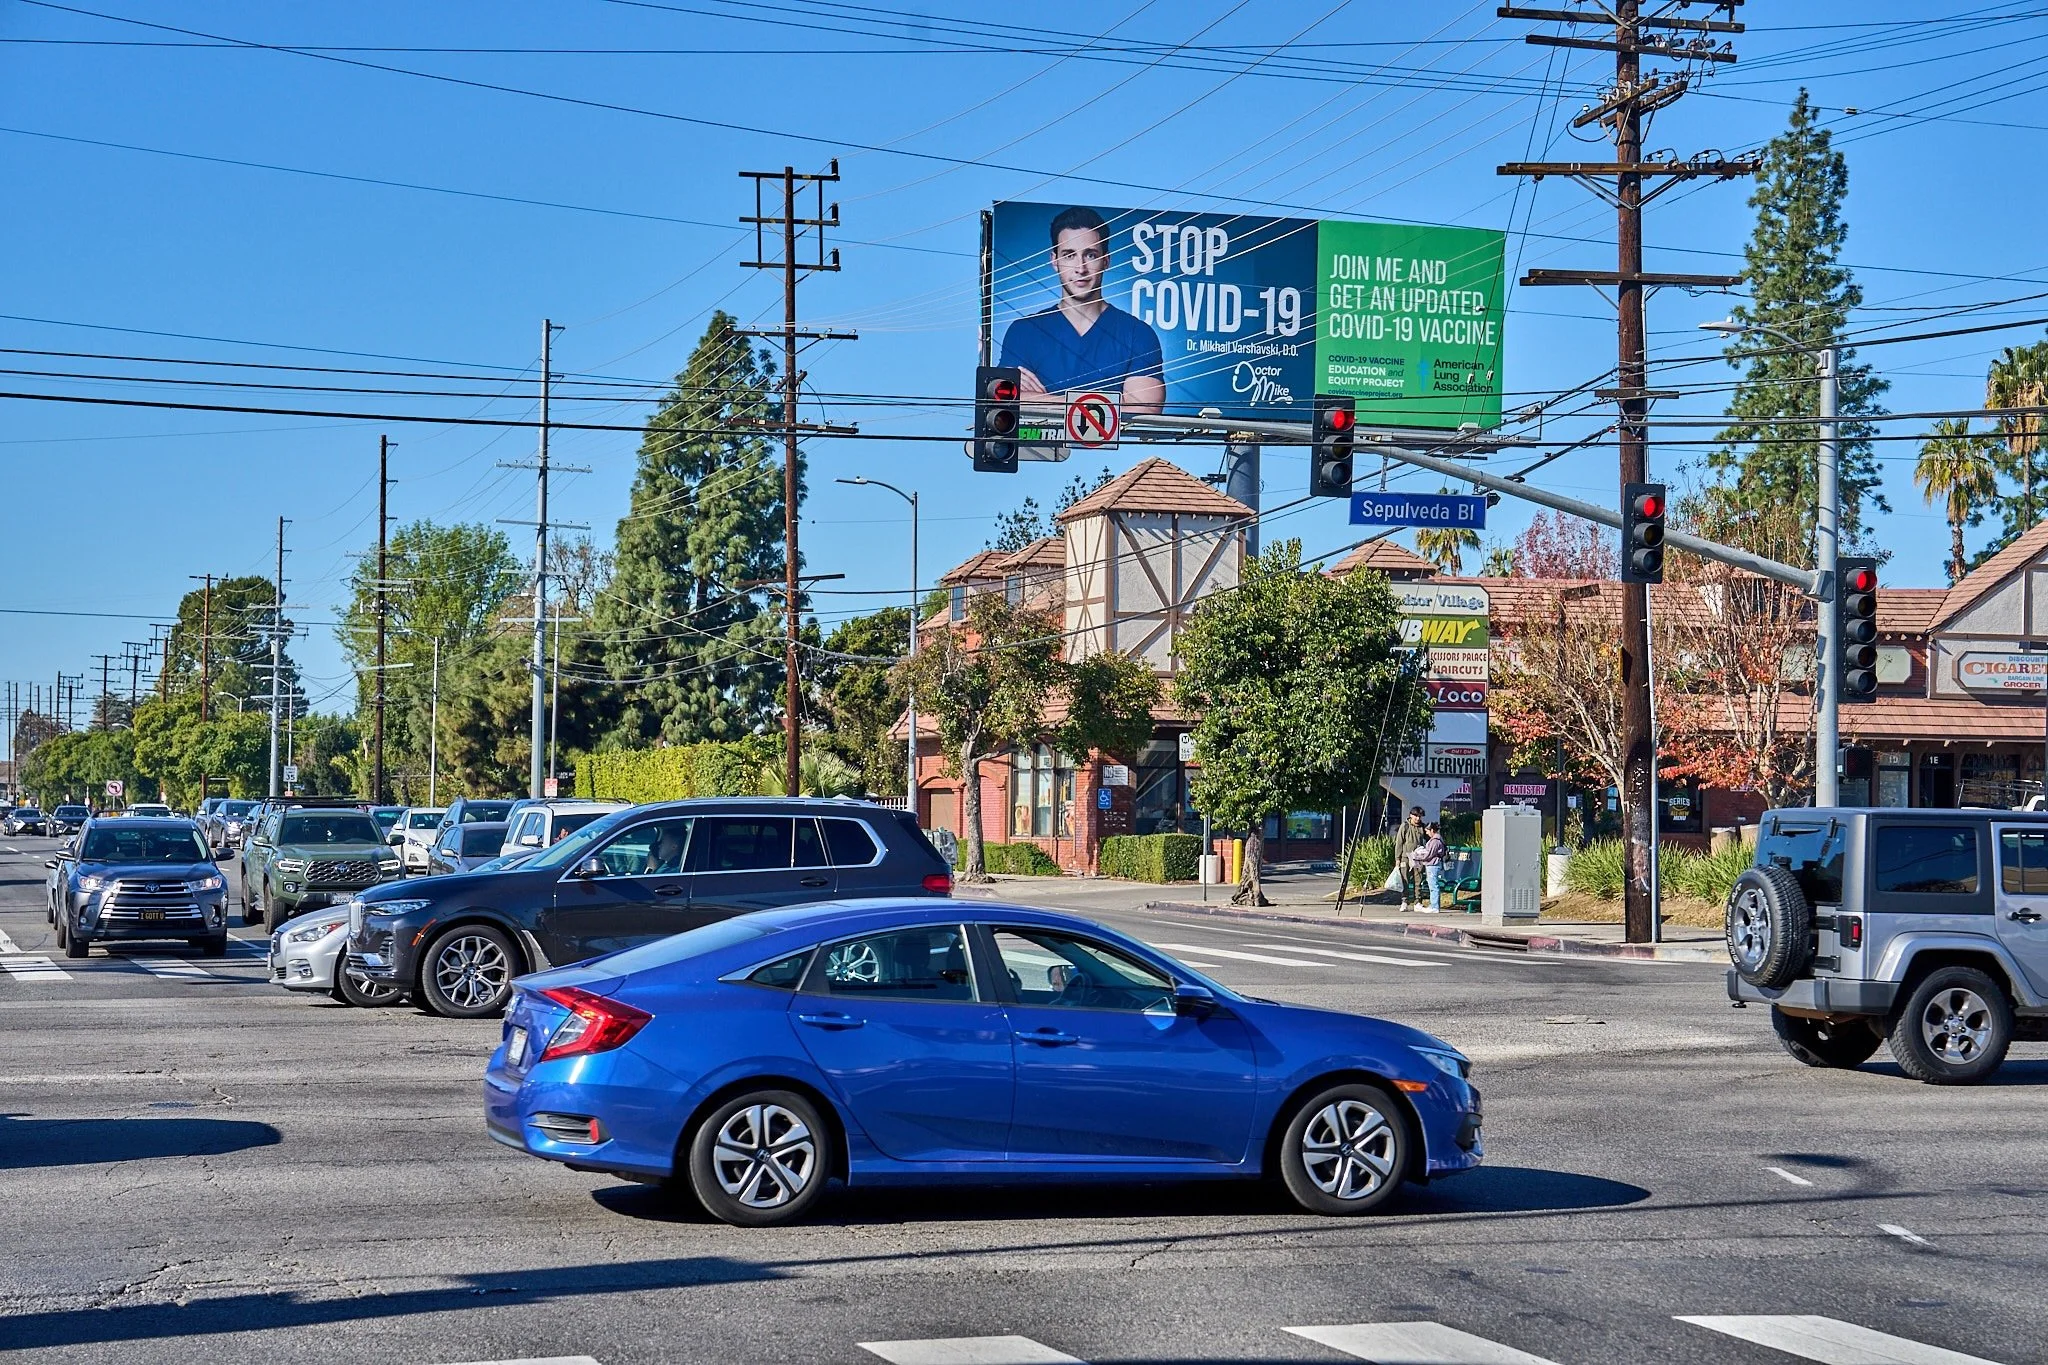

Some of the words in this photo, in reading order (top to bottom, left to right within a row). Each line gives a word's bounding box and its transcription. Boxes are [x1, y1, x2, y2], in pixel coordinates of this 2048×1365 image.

[1132, 222, 1229, 276] STOP
[1330, 254, 1369, 280] JOIN
[1376, 256, 1403, 282] ME
[1408, 259, 1447, 285] AND
[1330, 284, 1365, 310] GET
[1370, 286, 1395, 312] AN
[1402, 288, 1484, 316] UPDATED
[1132, 279, 1301, 337] COVID-19
[1329, 313, 1413, 342] COVID-19
[1419, 318, 1496, 346] VACCINE
[1187, 339, 1198, 351] Dr.
[1200, 340, 1230, 353] Mikhail
[1283, 344, 1299, 357] D.O.
[1328, 355, 1367, 364] COVID-19
[1369, 357, 1405, 366] VACCINE
[1433, 358, 1485, 371] American
[1328, 365, 1386, 376] EDUCATION
[1388, 369, 1404, 377] and
[1434, 370, 1459, 383] Lung
[1328, 376, 1362, 386] EQUITY
[1363, 378, 1405, 388] PROJECT
[1433, 381, 1493, 393] Association
[1362, 500, 1449, 521] Sepulveda
[1458, 504, 1475, 520] Bl
[1437, 594, 1485, 610] Village
[1400, 619, 1480, 644] BWAY
[1462, 652, 1487, 662] PALACE
[1433, 665, 1483, 675] HAIRCUTS
[1429, 757, 1486, 774] TERIYAKI
[1411, 778, 1440, 789] 6411
[1504, 784, 1547, 796] DENTISTRY
